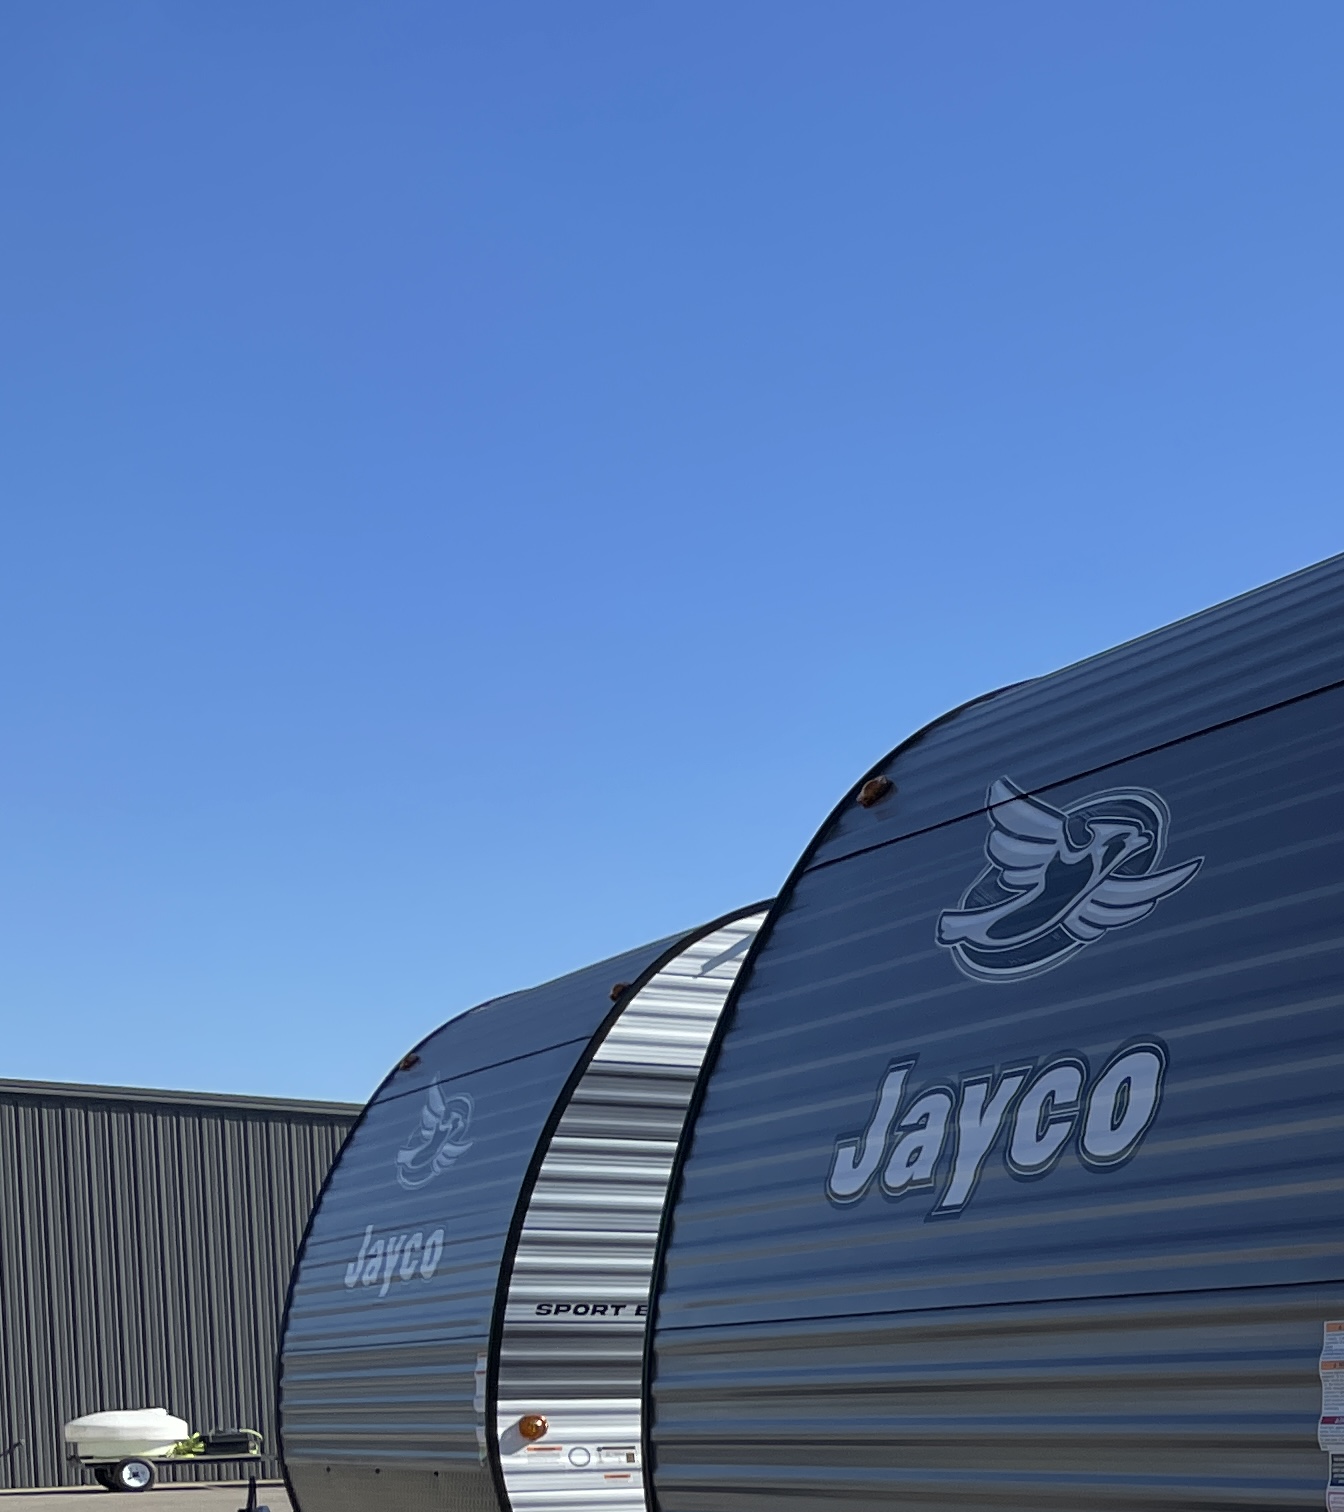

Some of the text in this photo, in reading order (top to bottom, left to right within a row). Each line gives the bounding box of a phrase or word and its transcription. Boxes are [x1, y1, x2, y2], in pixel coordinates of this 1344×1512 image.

[825, 1043, 1167, 1217] Jayco
[344, 1224, 445, 1298] Jayco
[535, 1303, 626, 1316] SPORT
